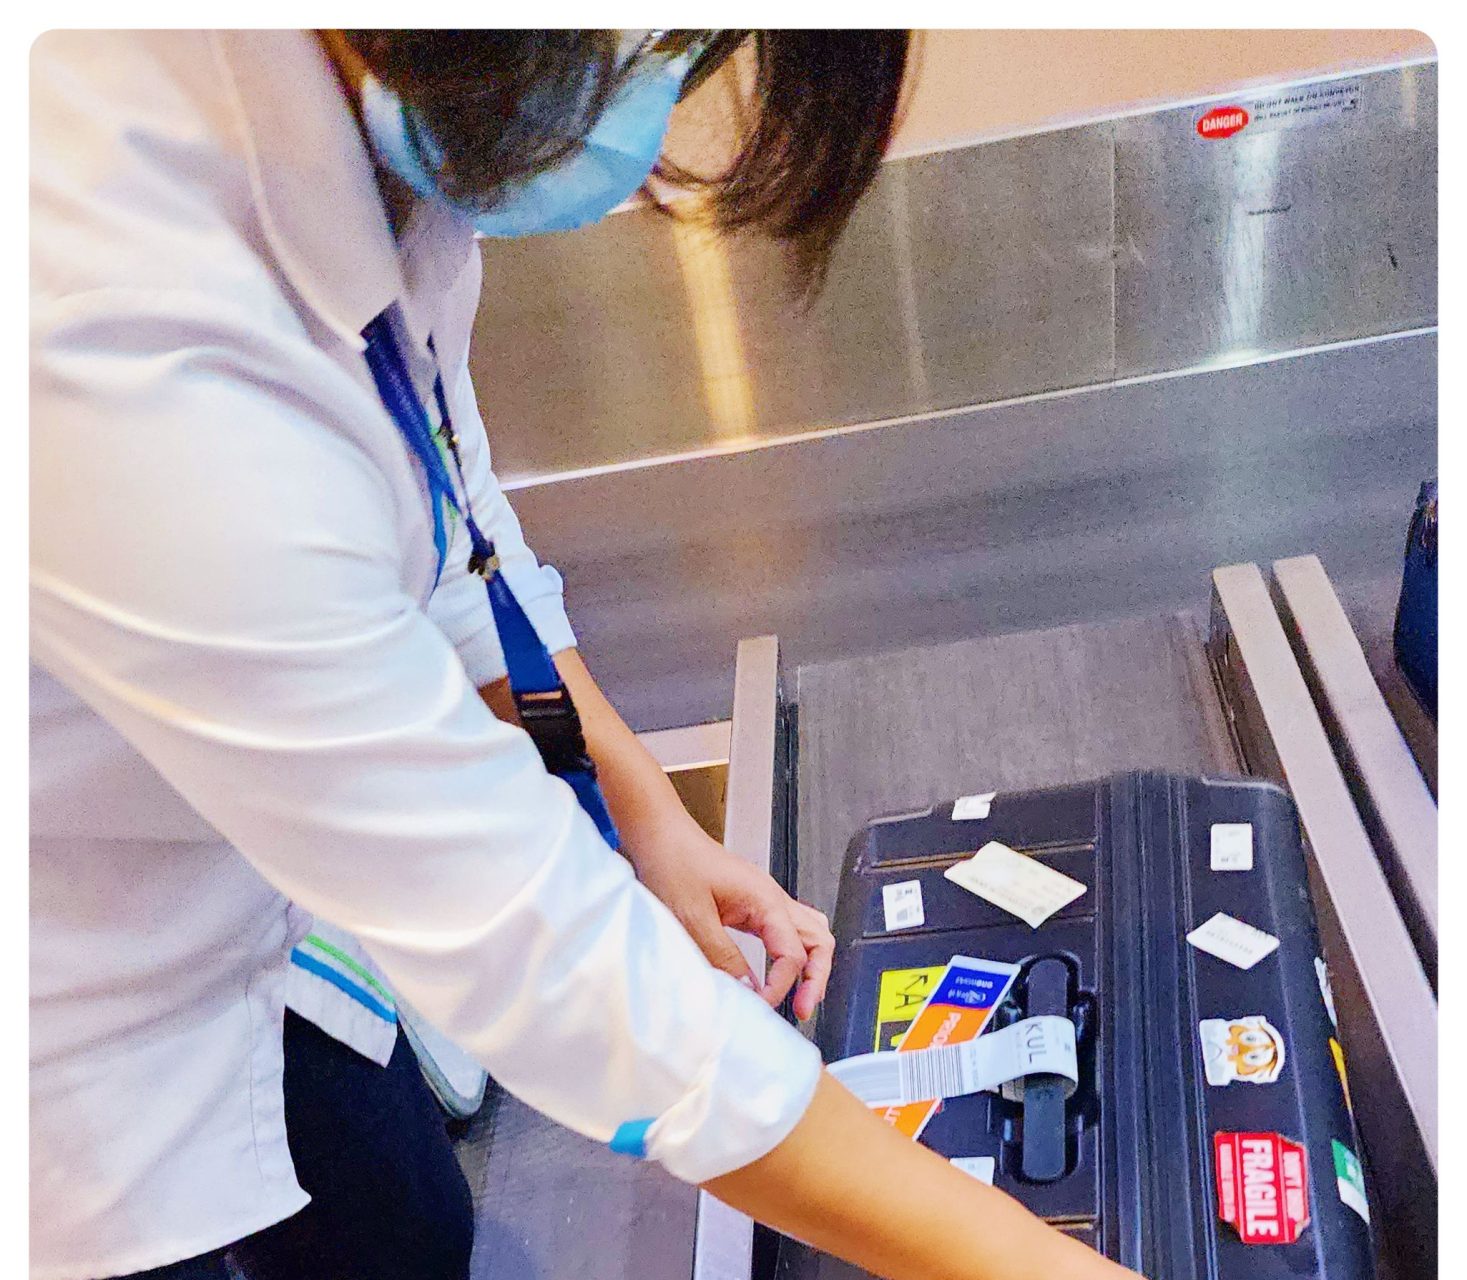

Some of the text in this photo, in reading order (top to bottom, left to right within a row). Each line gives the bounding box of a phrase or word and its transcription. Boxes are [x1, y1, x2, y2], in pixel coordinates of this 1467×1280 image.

[1202, 112, 1243, 133] DANGER
[1024, 1021, 1048, 1065] KUL
[1241, 1138, 1280, 1237] FRAGILE
